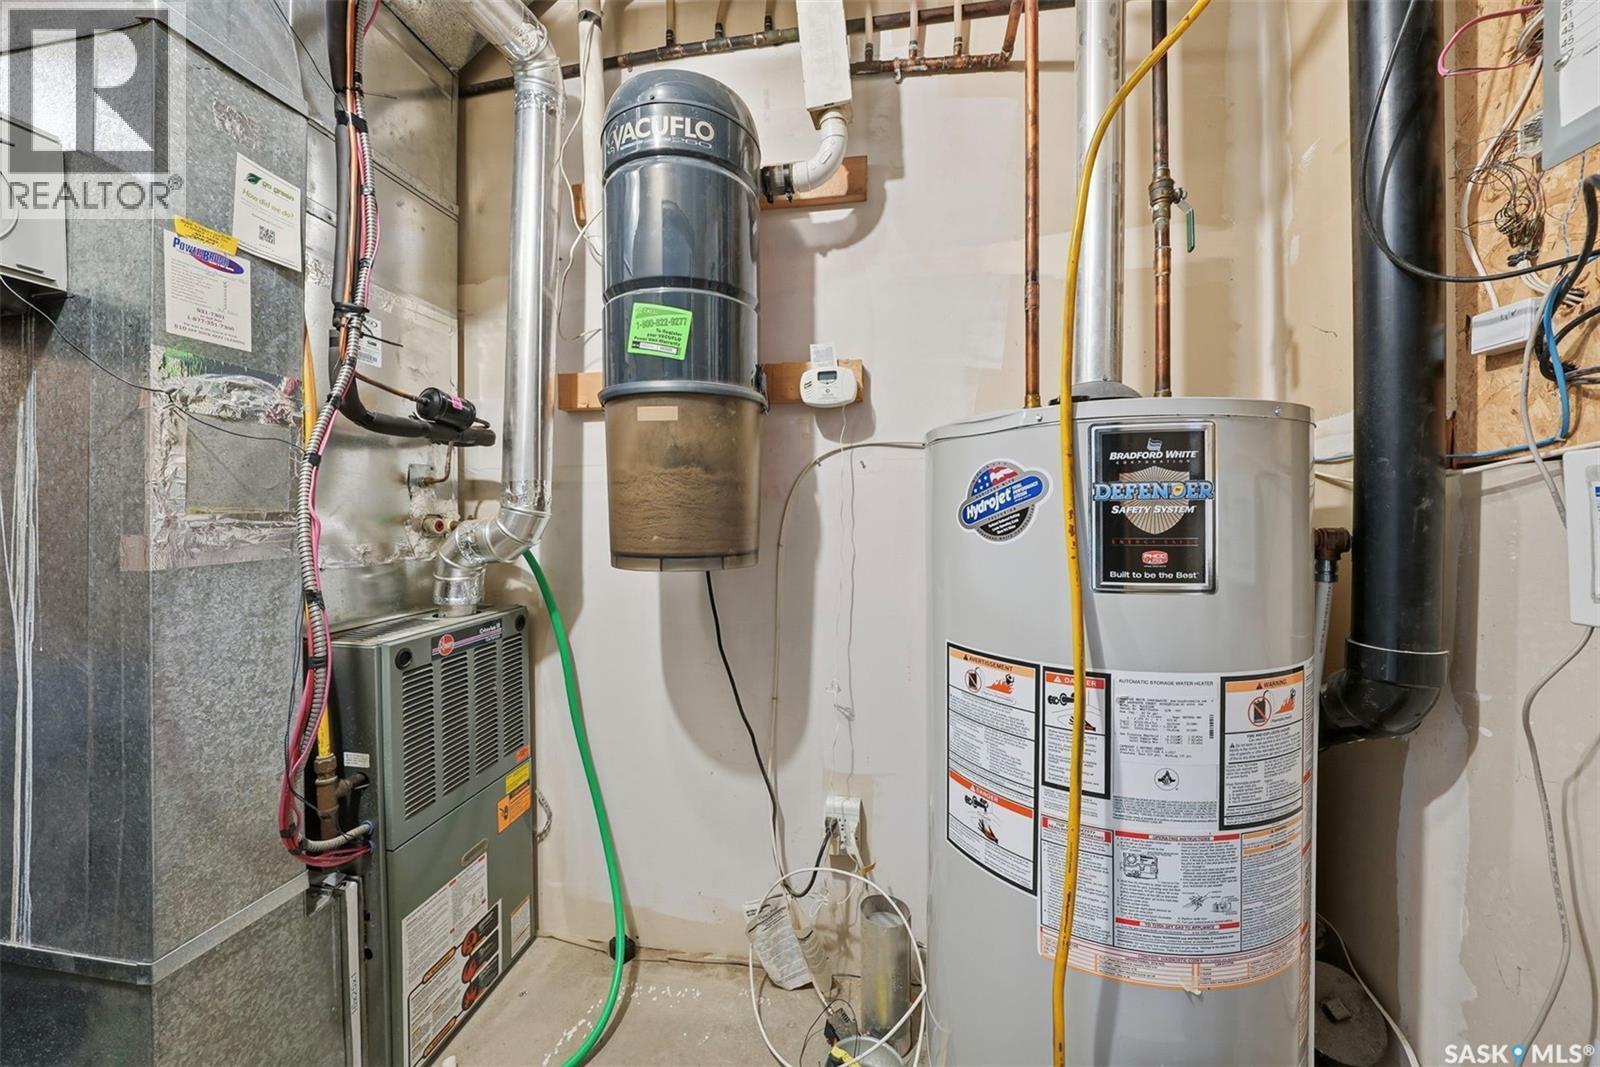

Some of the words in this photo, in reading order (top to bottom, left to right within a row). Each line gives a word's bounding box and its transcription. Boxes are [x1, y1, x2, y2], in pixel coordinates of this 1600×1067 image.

[1561, 34, 1574, 48] 45
[612, 115, 715, 151] VACUFLO
[242, 188, 258, 202] How
[259, 198, 271, 209] did
[1109, 450, 1163, 460] BRADFORD
[1165, 450, 1198, 458] WHITE
[1093, 481, 1215, 501] DEFENDER
[966, 487, 1012, 520] Hydrojet
[1111, 505, 1152, 515] SAFETY
[1153, 505, 1196, 514] SYSTEM
[1109, 570, 1131, 578] Built
[1132, 571, 1142, 579] to
[1143, 571, 1156, 579] be
[1158, 571, 1173, 579] the
[1064, 676, 1097, 687] DAER
[1263, 679, 1287, 688] WARNING
